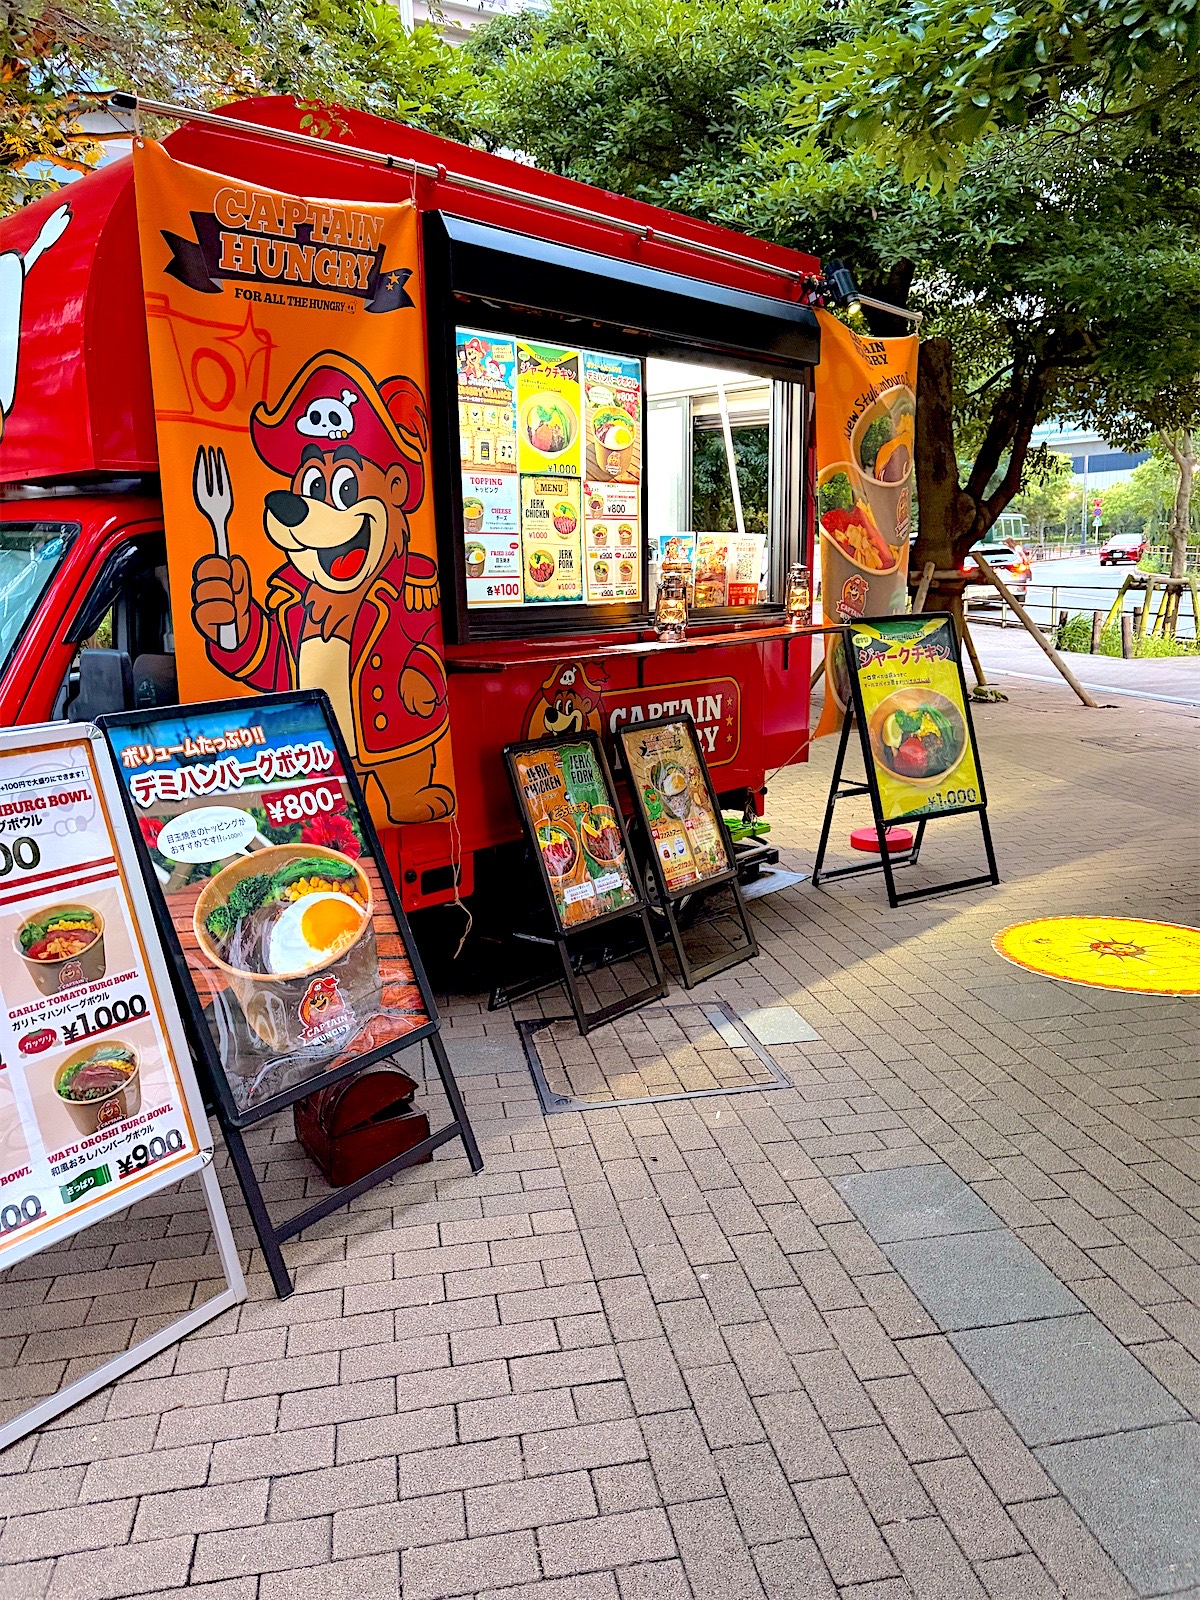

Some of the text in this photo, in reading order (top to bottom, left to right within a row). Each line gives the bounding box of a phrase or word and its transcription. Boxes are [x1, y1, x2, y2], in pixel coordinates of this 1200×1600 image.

[213, 187, 385, 252] CAPTAIN
[219, 231, 375, 290] HUNGRY
[234, 287, 345, 312] FOR ALL THE HUNGRY
[520, 361, 577, 381] ジャークチキン
[470, 477, 503, 486] TOPPING
[540, 483, 563, 493] MENU
[525, 509, 550, 519] CHICKEN
[530, 499, 544, 509] JERK
[607, 504, 626, 514] ¥800
[559, 550, 573, 559] JERK
[559, 560, 574, 569] PORK
[859, 644, 950, 669] ジャークチキン
[609, 694, 723, 734] CAPTAIN
[526, 763, 550, 783] JERK
[569, 754, 592, 771] JERK
[133, 744, 333, 804] デミハンバーグボウル
[47, 789, 92, 808] BOWL
[8, 970, 139, 1020] GARLIC TOMATO BURG BOWL
[11, 991, 110, 1032] ガリトマハンバーグボウル
[306, 1014, 350, 1038] CAPTAIN
[25, 1033, 52, 1050] ガッツリ
[47, 1104, 174, 1164] WAFU OROSHI BURG BOWL
[50, 1124, 155, 1178] 和風おろしハンバーグボウル
[116, 1129, 184, 1175] ¥900
[0, 1166, 33, 1187] BOWL
[66, 1176, 95, 1196] さっぱり
[0, 1195, 42, 1232] 00
